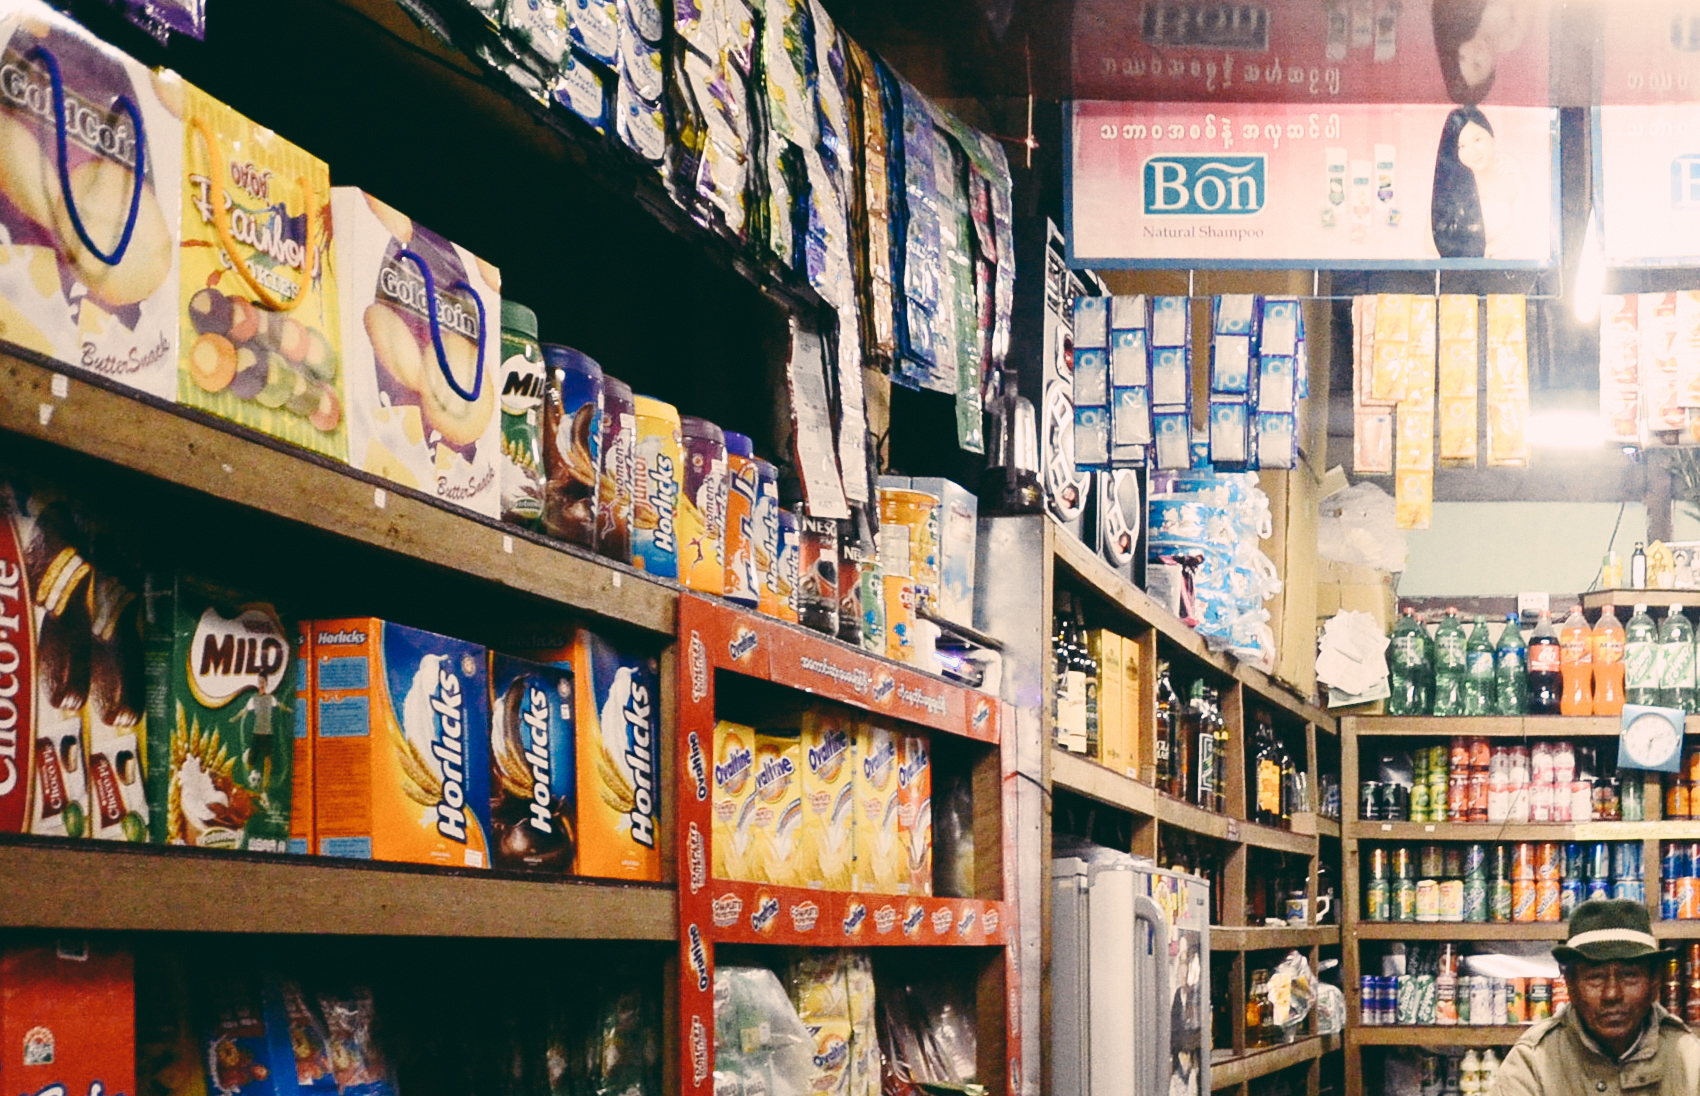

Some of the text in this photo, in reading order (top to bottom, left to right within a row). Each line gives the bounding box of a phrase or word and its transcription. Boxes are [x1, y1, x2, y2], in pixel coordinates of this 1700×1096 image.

[1143, 225, 1264, 240] Natural Shampoo
[650, 452, 674, 553] Horlicks
[200, 633, 284, 676] MILO
[318, 630, 366, 646] Horlicks
[728, 629, 759, 662] Ovaltine
[430, 668, 467, 842] Horlicks
[522, 686, 552, 835] Horlicks
[622, 680, 655, 848] Horlicks
[687, 731, 707, 802] Ovaltine
[715, 746, 752, 788] Ovaltine
[755, 754, 795, 792] valtine
[808, 730, 848, 775] Ovaltine
[864, 740, 895, 782] Ovaltine
[751, 898, 780, 934] Ovaltine
[688, 923, 710, 993] Ovaltine
